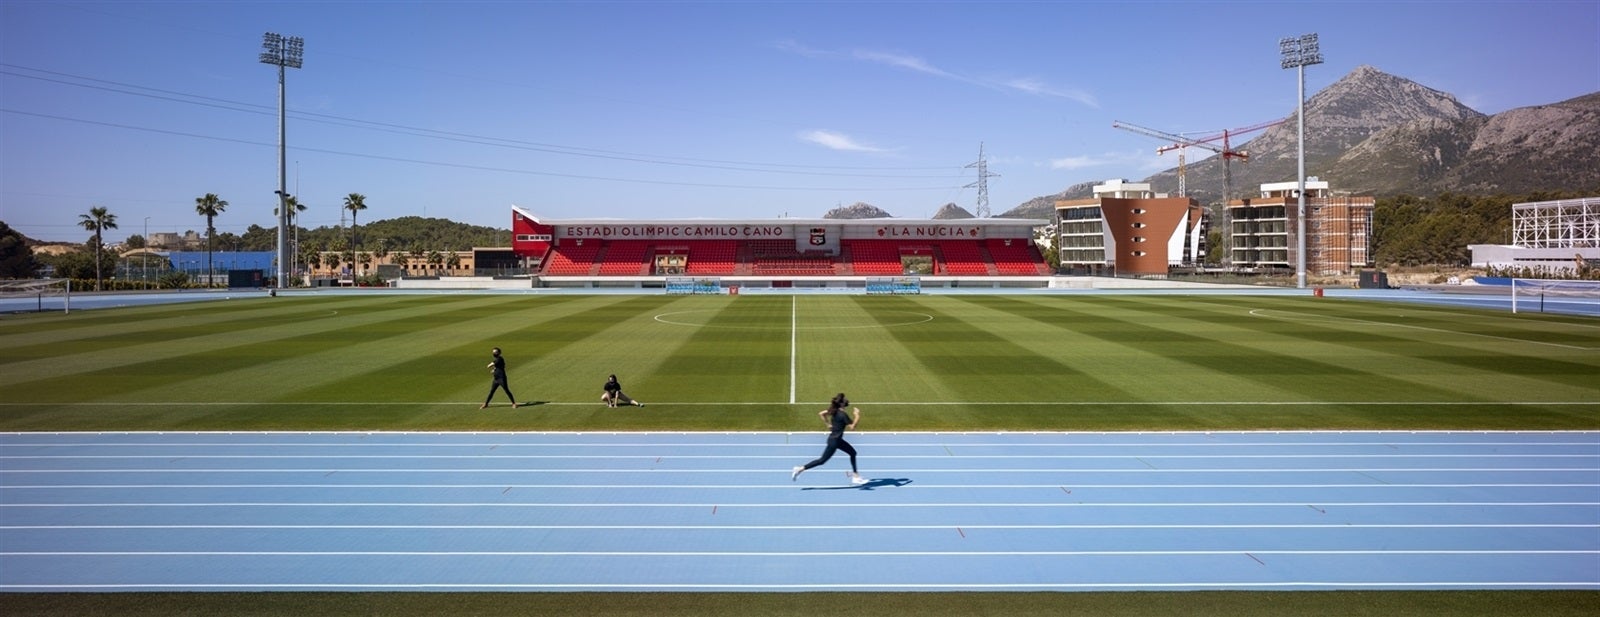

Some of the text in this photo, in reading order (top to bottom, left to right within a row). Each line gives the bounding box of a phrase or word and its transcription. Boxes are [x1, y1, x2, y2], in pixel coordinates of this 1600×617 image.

[567, 226, 783, 236] ESTADI OLIMPIC CAMILO CANO
[892, 226, 965, 236] LA NUCIA
